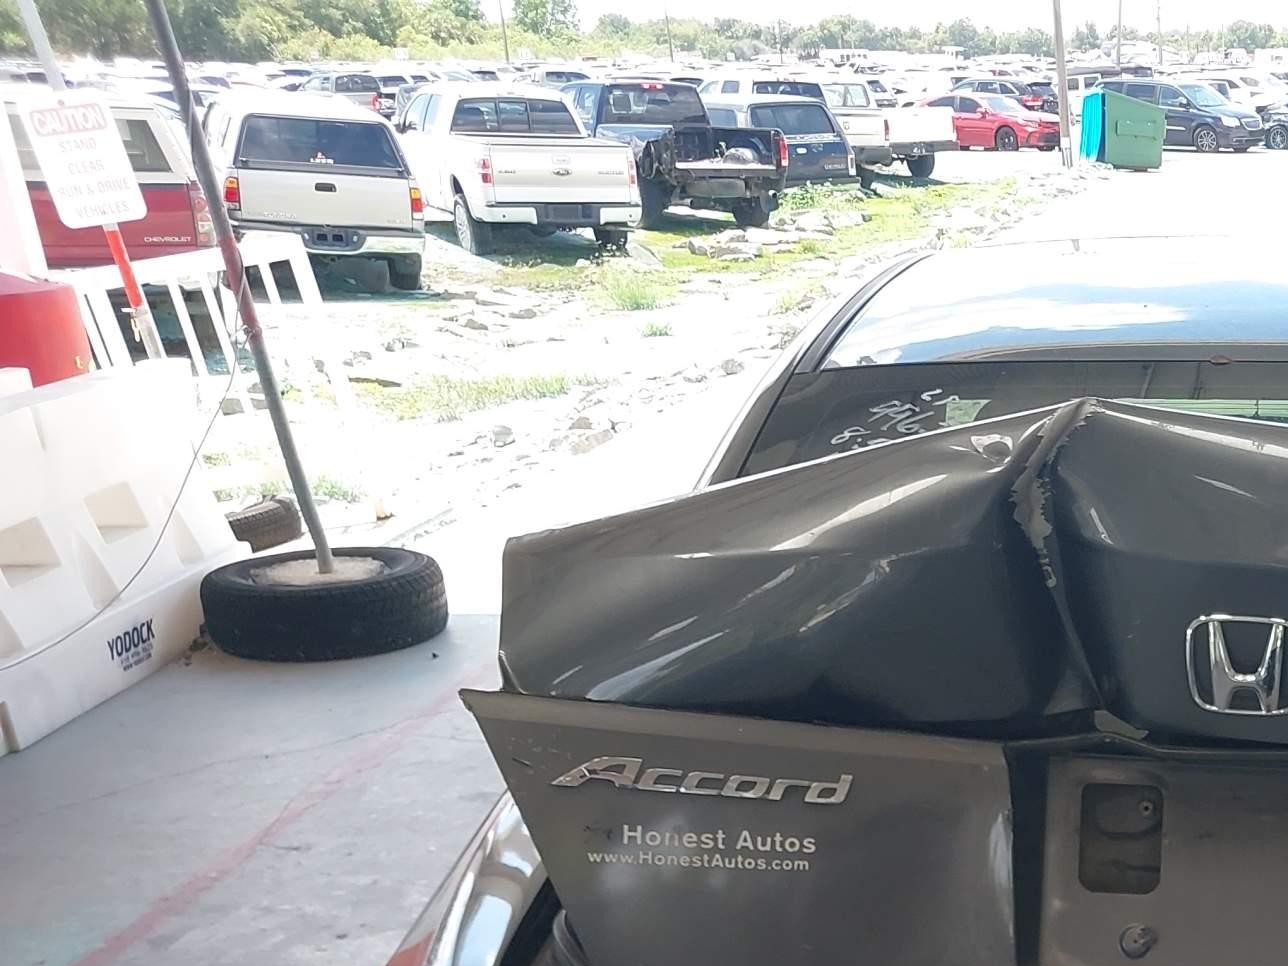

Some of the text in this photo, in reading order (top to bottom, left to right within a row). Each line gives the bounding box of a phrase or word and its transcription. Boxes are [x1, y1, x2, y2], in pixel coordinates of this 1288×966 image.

[32, 106, 105, 134] CAUTION
[57, 137, 97, 152] STAND
[68, 159, 105, 175] CLEAR
[57, 184, 83, 199] RUN
[97, 176, 131, 193] DRIVE
[75, 200, 130, 219] VEHICLES
[107, 618, 155, 660] YODOCK
[551, 756, 854, 804] Accord
[622, 824, 817, 854] Honest Autos
[587, 850, 810, 872] www.HonestAutos.com
